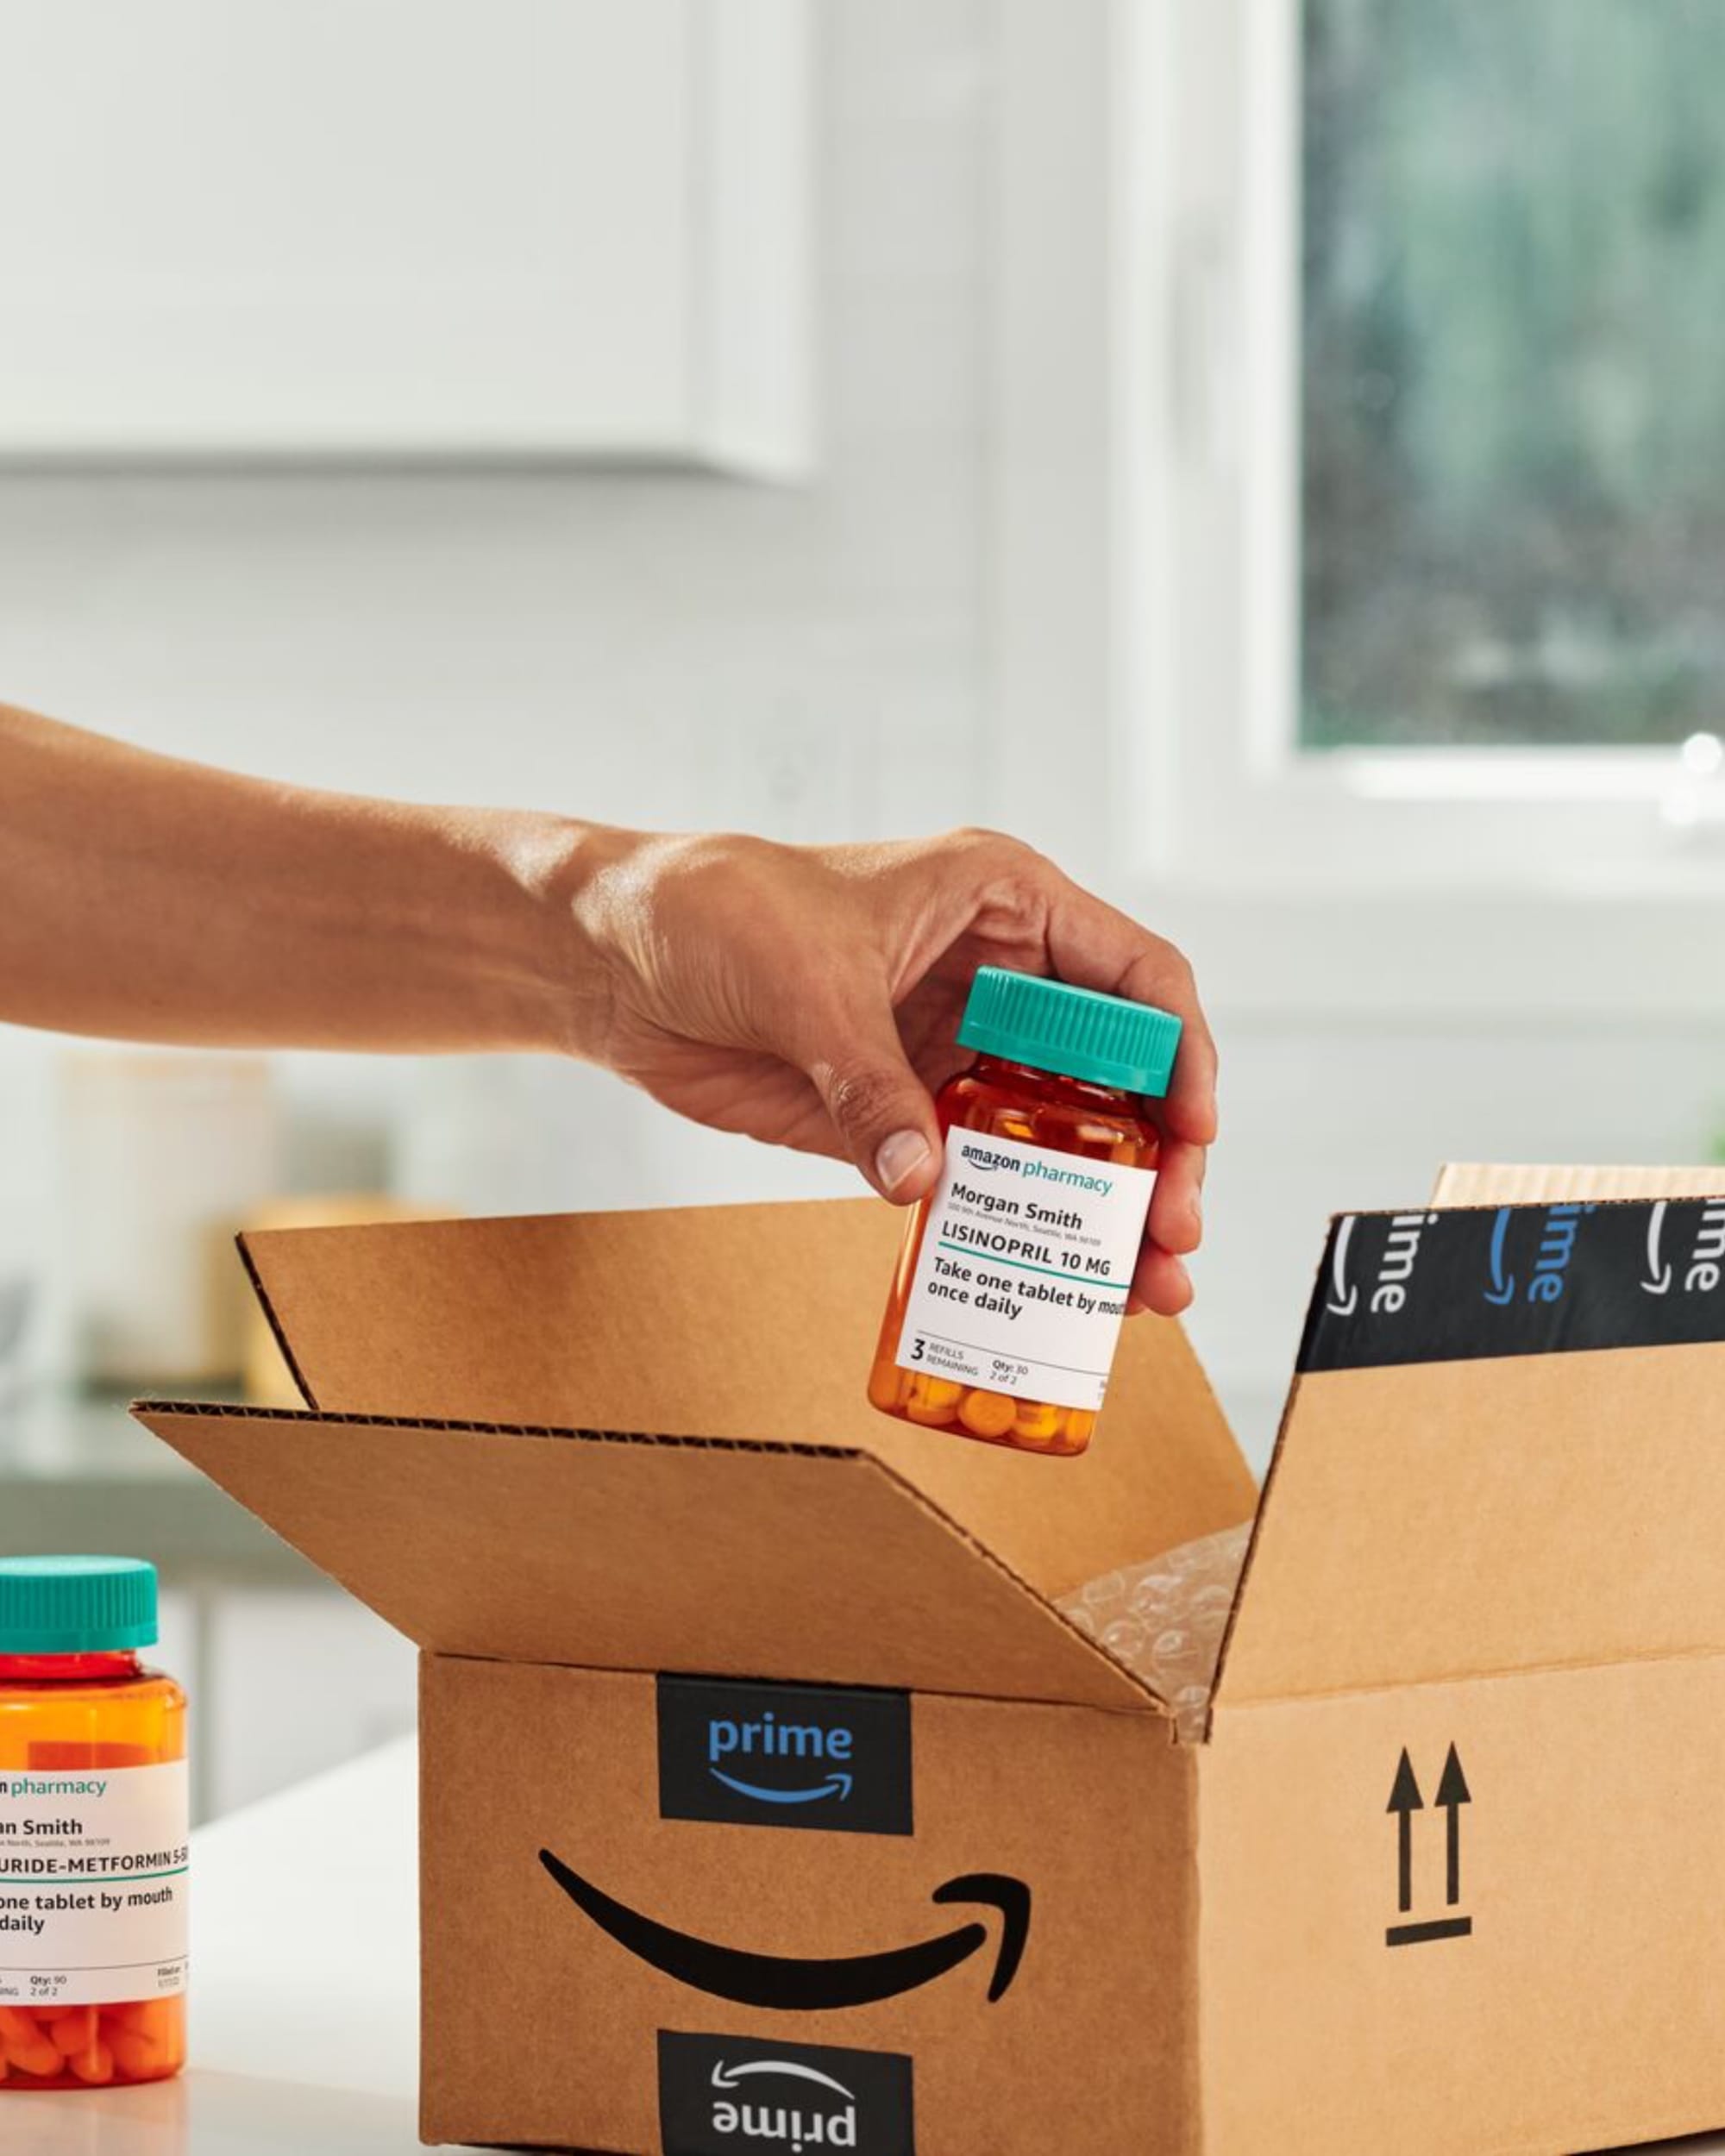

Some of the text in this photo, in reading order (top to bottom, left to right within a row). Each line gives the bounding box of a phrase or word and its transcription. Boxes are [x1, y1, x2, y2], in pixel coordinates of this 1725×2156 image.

[961, 1145, 1112, 1196] amazon pharmacy
[951, 1182, 1082, 1230] Morgan Smith
[942, 1221, 1110, 1275] LISINOPRIL 10 MG
[935, 1257, 972, 1282] Take
[976, 1273, 1012, 1293] one
[1018, 1282, 1073, 1307] tablet
[1076, 1293, 1096, 1314] by
[928, 1282, 1022, 1320] once daily
[911, 1338, 925, 1360] 3
[929, 1343, 963, 1360] REFILLS
[926, 1354, 978, 1376] REMAINING
[989, 1370, 997, 1380] 2
[998, 1372, 1009, 1382] of
[992, 1359, 1013, 1373] Qty:
[709, 1712, 851, 1761] prime
[11, 1777, 106, 1797] pharmacy
[23, 1818, 83, 1835] Smith
[34, 1893, 95, 1909] tablet
[101, 1893, 122, 1912] by
[129, 1887, 172, 1907] mouth
[0, 1914, 45, 1935] daily
[30, 1976, 51, 1985] Qty:
[30, 1987, 58, 1996] 2 of 2
[712, 2102, 856, 2153] prime
